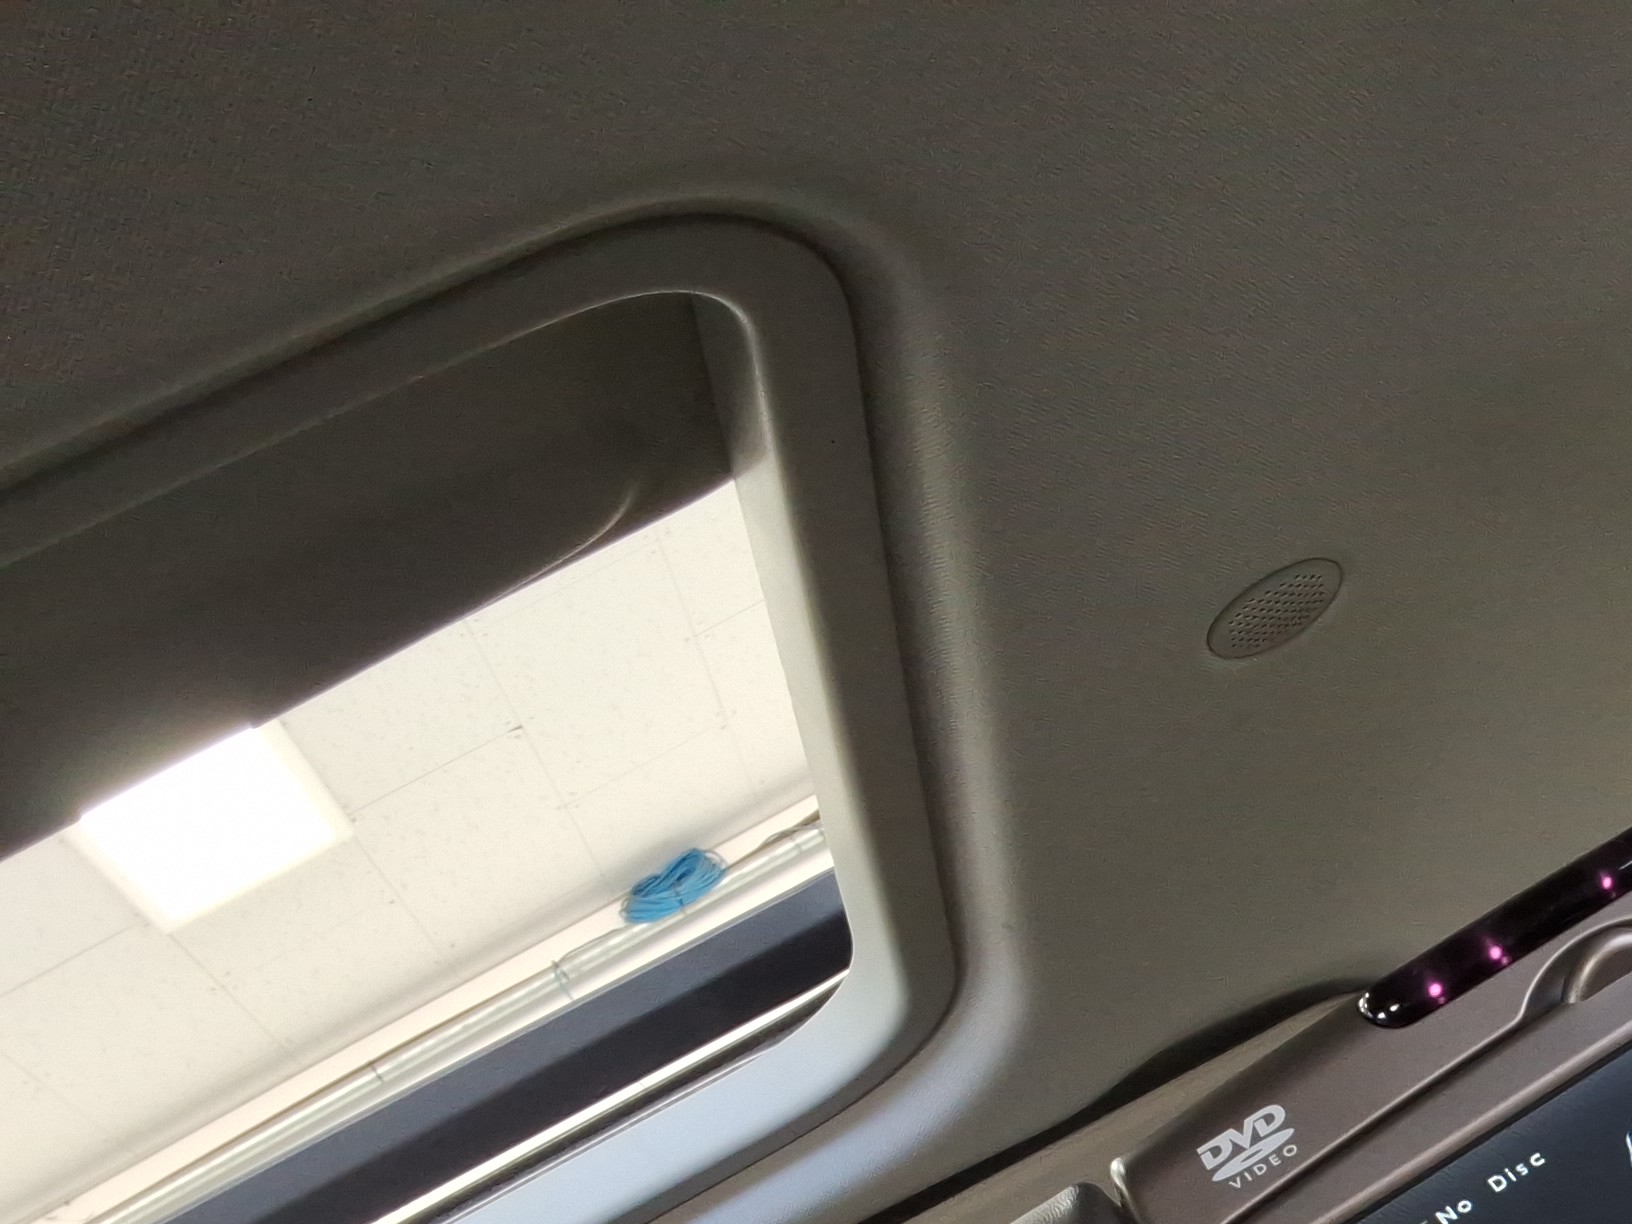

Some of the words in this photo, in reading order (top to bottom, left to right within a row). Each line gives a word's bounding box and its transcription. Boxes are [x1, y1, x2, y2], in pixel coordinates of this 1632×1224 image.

[1196, 1104, 1286, 1171] DVD
[1228, 1144, 1298, 1189] VIDEO
[1487, 1152, 1546, 1192] Disc
